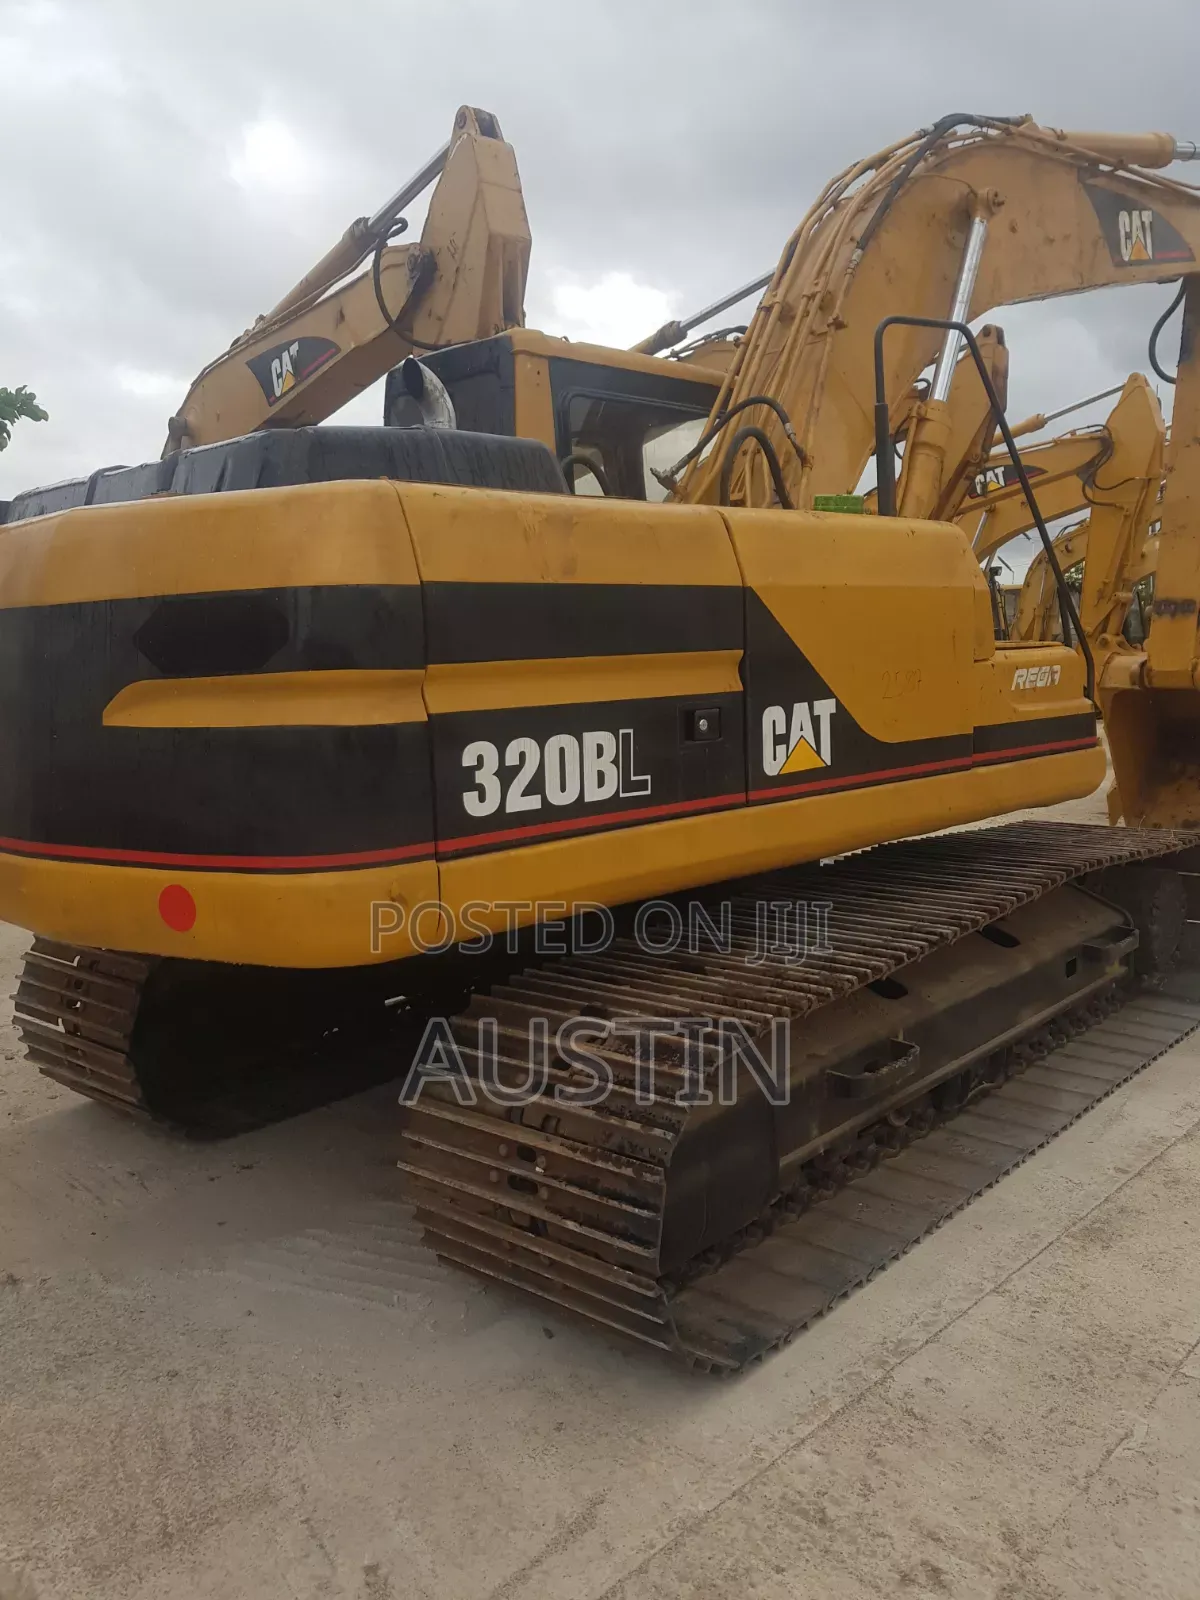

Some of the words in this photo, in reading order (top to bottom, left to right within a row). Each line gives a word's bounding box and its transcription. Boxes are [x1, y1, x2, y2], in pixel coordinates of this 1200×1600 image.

[1118, 210, 1153, 261] CAT
[271, 341, 300, 397] CAT
[975, 466, 1006, 496] CAT
[762, 698, 837, 777] CAT
[461, 728, 651, 817] 320BL
